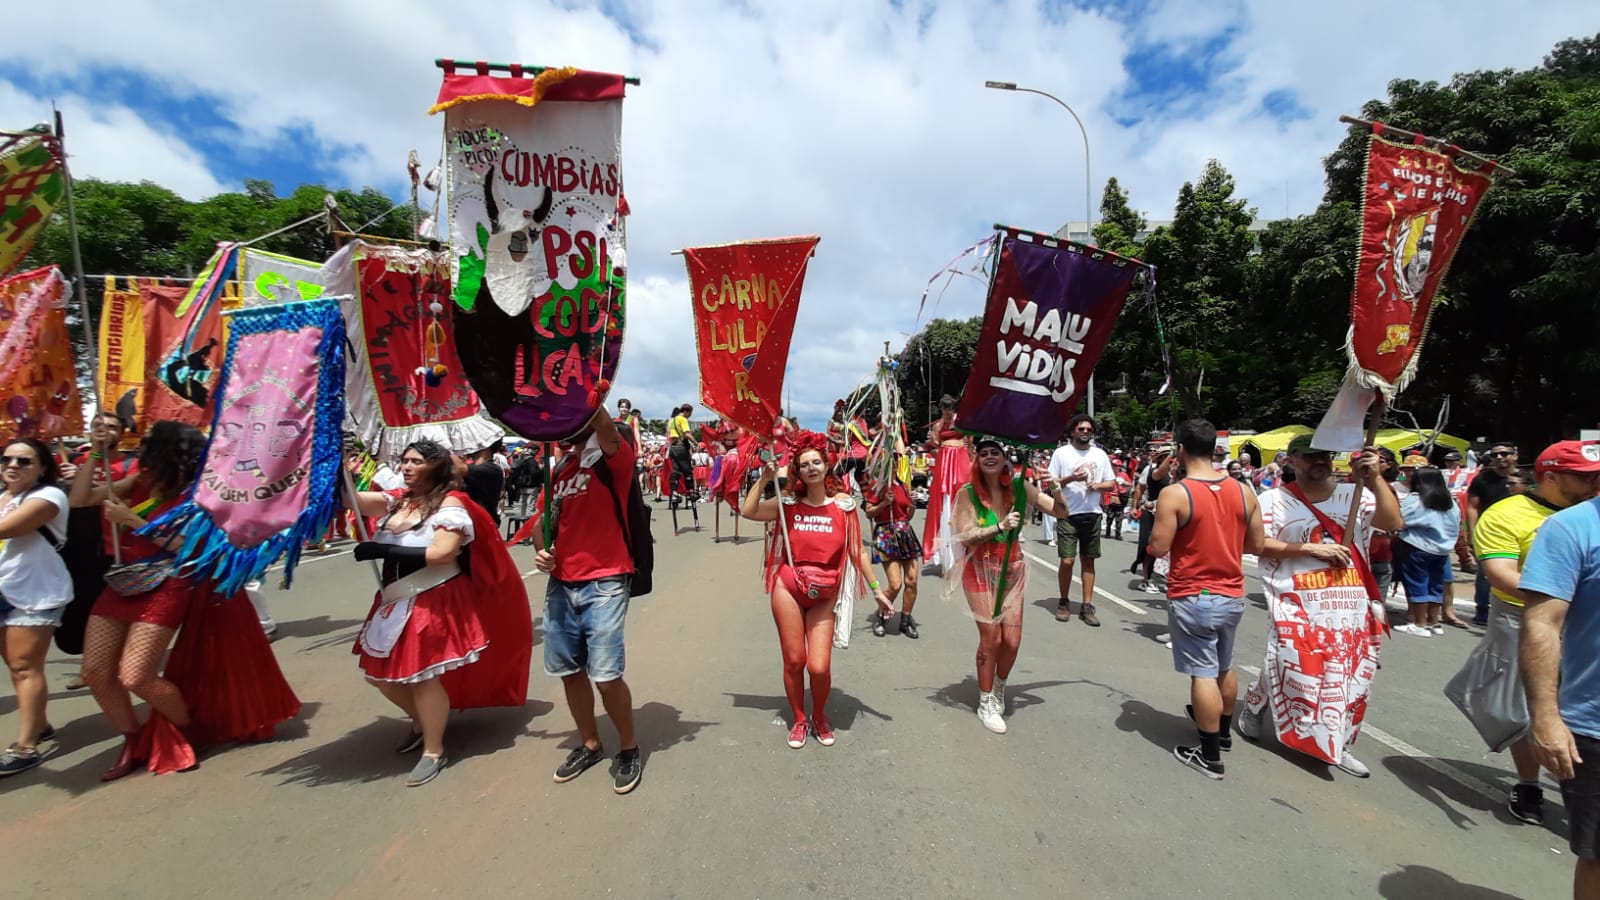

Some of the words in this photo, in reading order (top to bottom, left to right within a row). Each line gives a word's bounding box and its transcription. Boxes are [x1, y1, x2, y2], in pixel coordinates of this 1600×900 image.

[542, 225, 608, 282] PSI
[701, 273, 784, 312] CARNA
[1000, 296, 1092, 355] MALU
[254, 466, 307, 500] QUER
[793, 522, 833, 533] venceu
[803, 515, 833, 525] amor
[1331, 568, 1364, 586] ANO
[1307, 592, 1319, 602] DE
